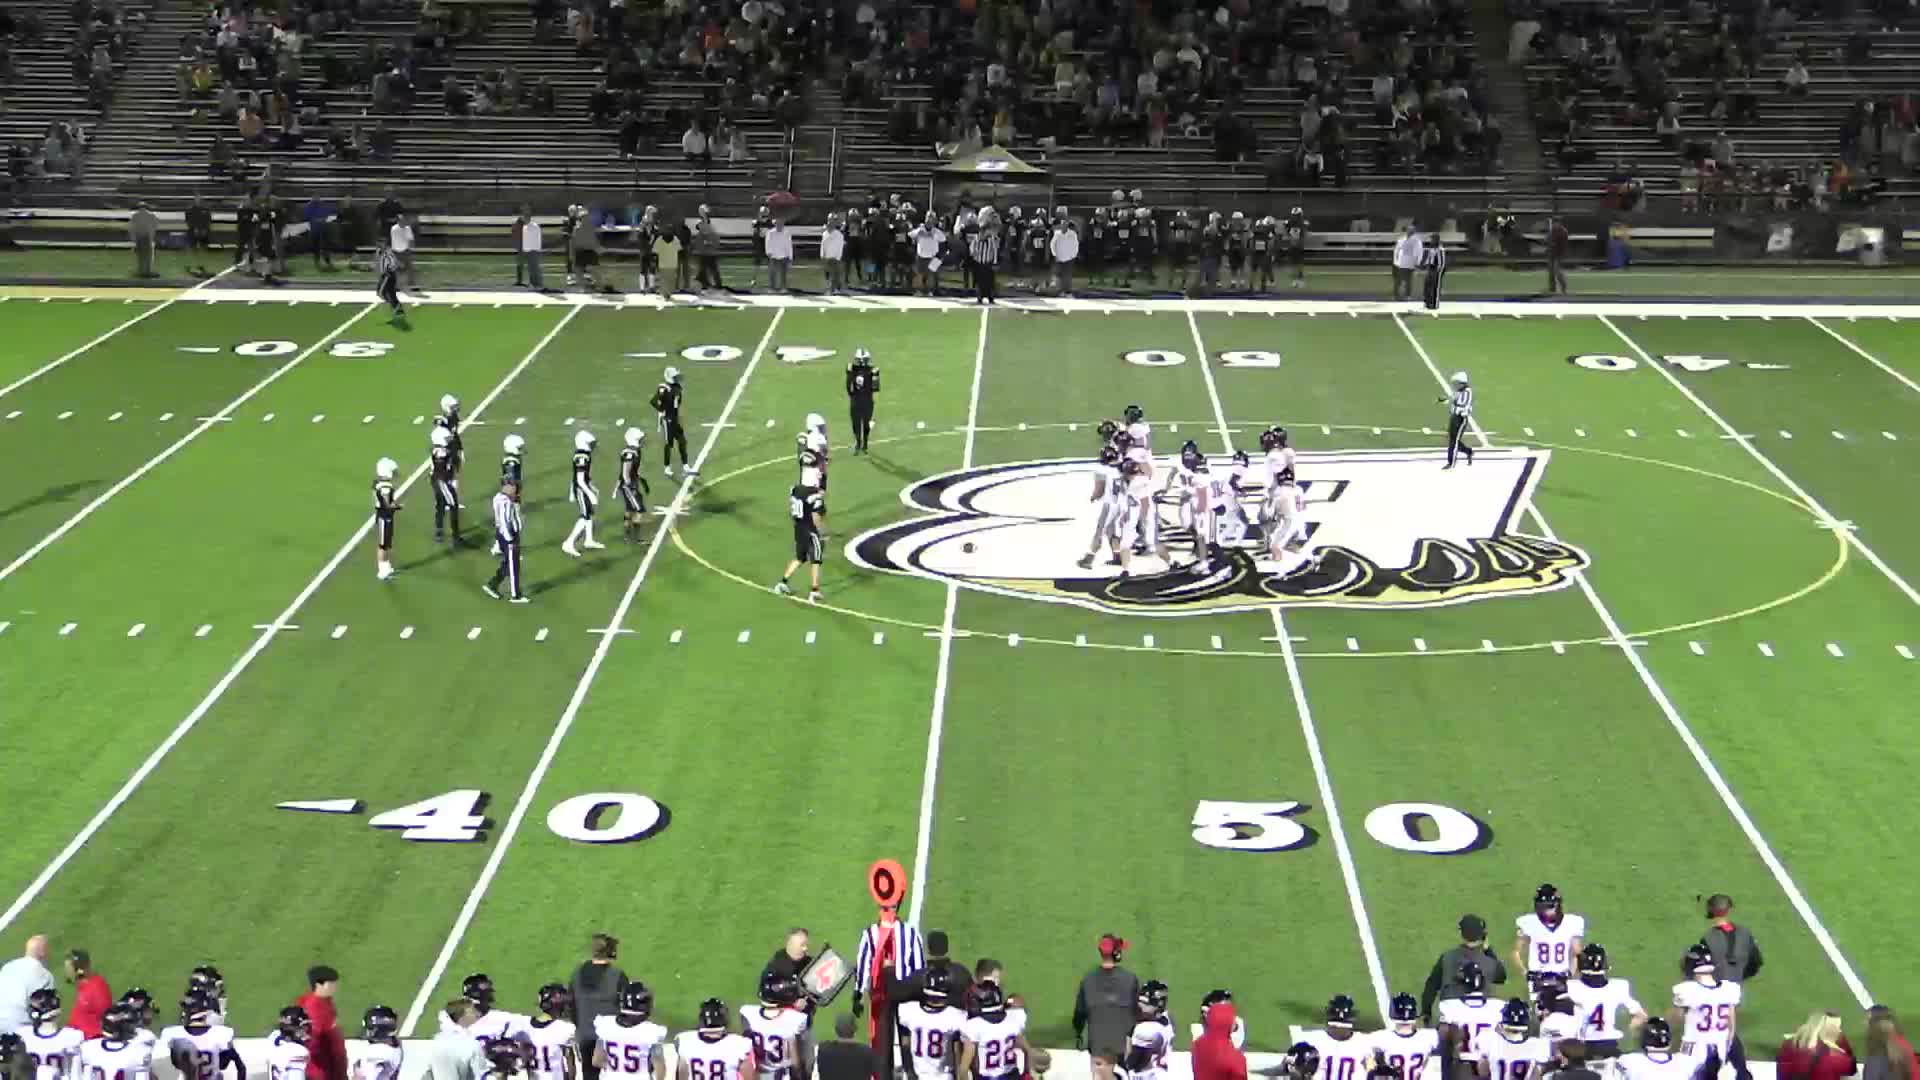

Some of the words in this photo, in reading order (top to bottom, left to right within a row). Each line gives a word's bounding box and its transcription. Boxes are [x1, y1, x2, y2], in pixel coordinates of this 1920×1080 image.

[1538, 942, 1566, 965] 88
[1588, 1003, 1606, 1033] 4
[1695, 1003, 1730, 1033] 35
[606, 1041, 640, 1073] 55
[915, 1027, 943, 1059] 18
[985, 1035, 1018, 1070] 22
[690, 1058, 725, 1080] 68
